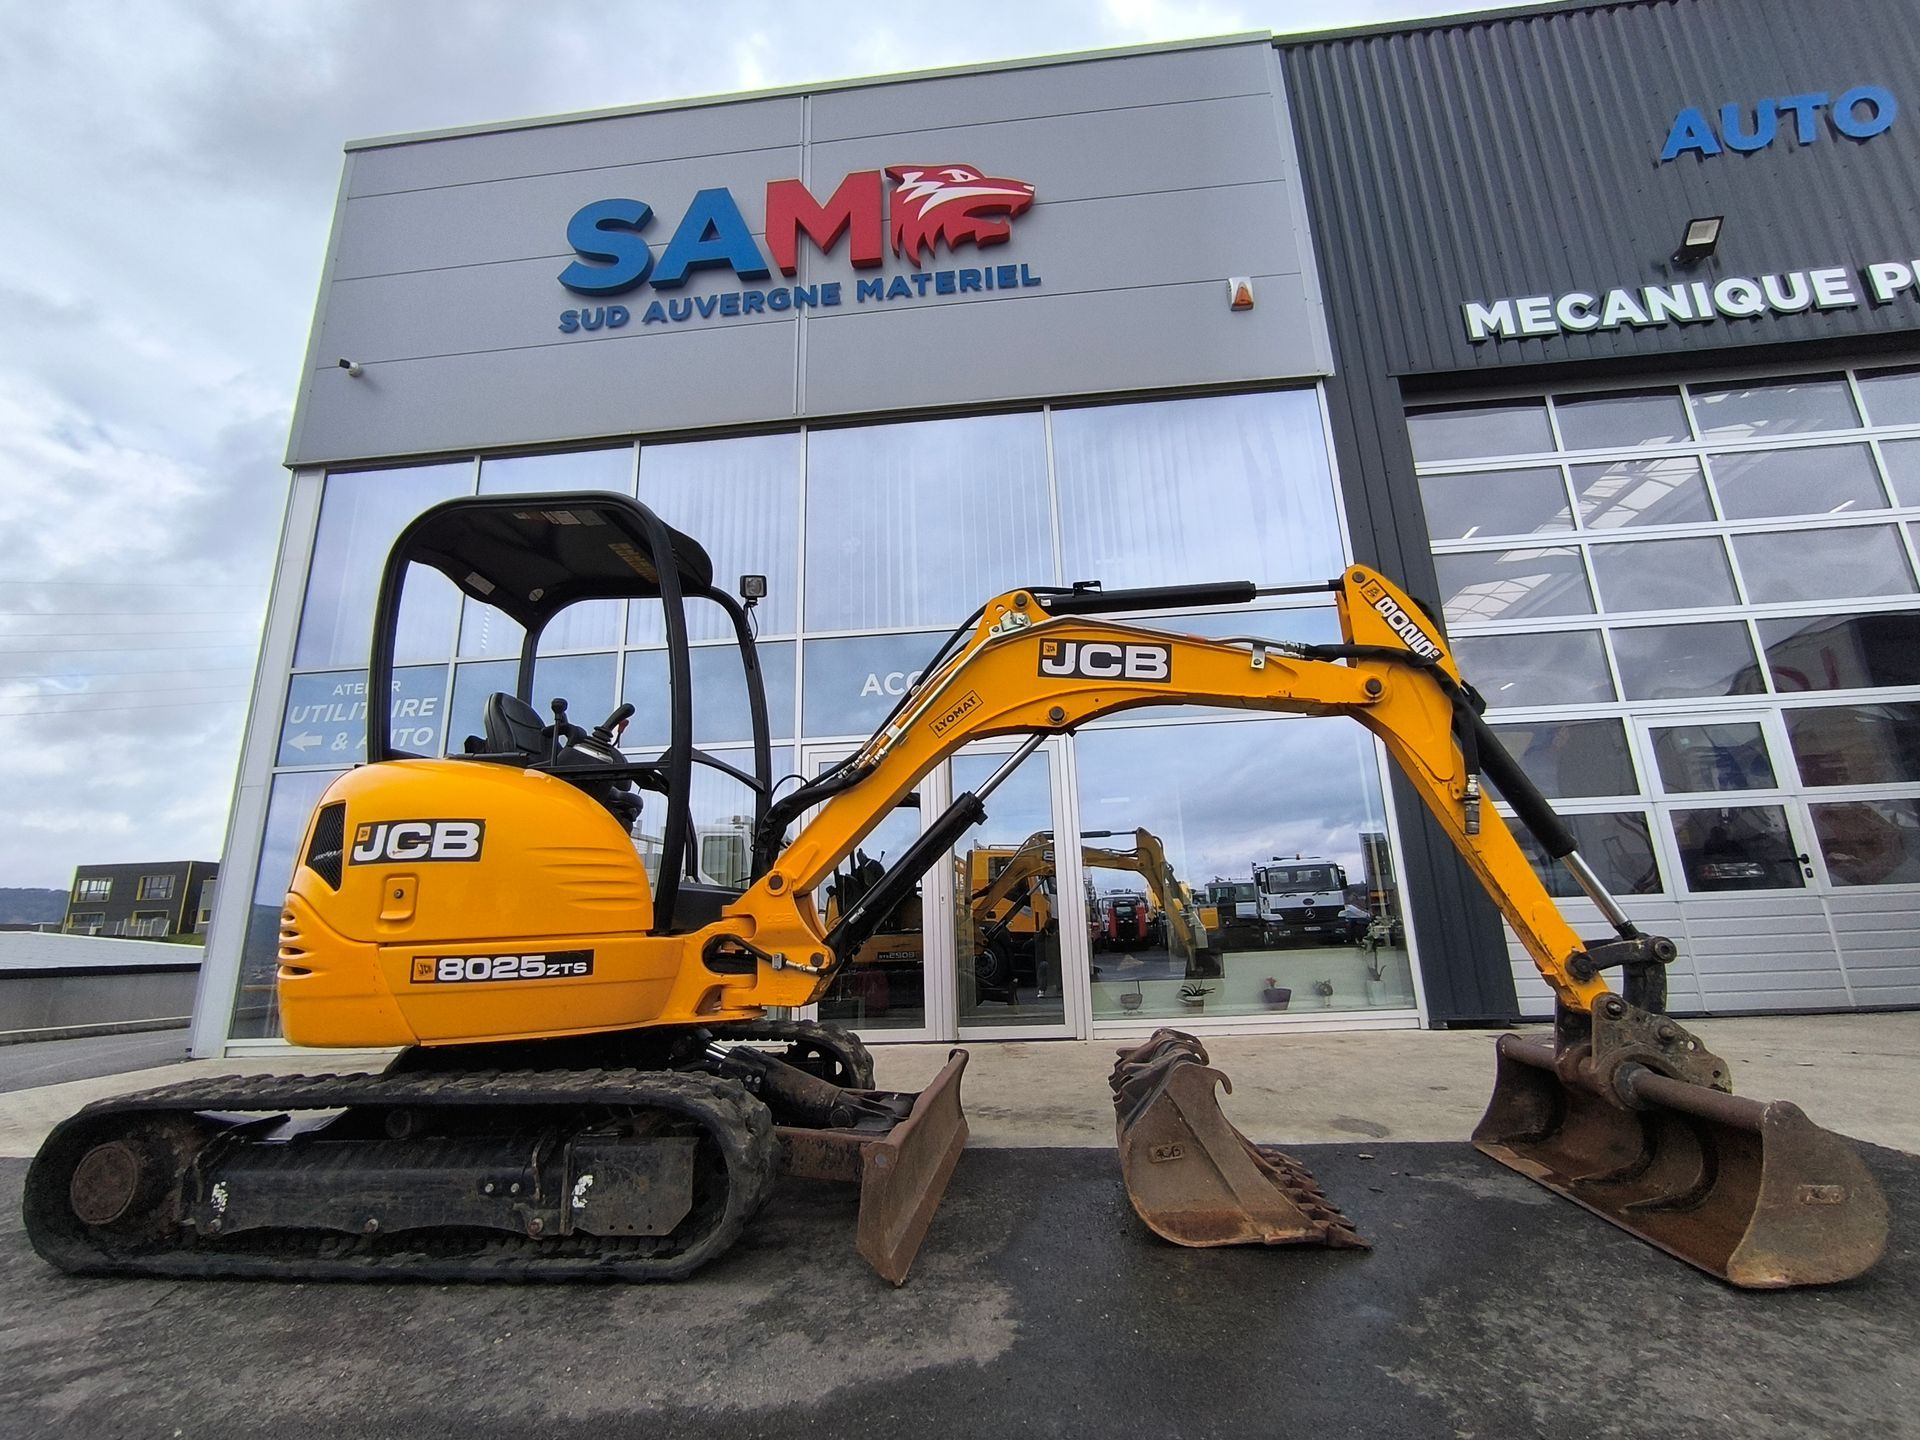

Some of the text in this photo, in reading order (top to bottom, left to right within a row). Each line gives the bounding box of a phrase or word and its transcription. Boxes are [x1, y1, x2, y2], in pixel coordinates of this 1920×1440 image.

[1660, 85, 1898, 161] AUTO
[558, 169, 884, 297] SAM
[559, 263, 1042, 333] SUD AUVERGNE MATERIEL
[1464, 266, 1858, 341] MECANIQUE
[1041, 642, 1168, 679] JCB
[332, 680, 402, 696] ATER
[290, 697, 438, 724] UTILITIRE
[934, 695, 977, 733] LYOMAT
[330, 731, 348, 751] &
[352, 822, 480, 862] JCB
